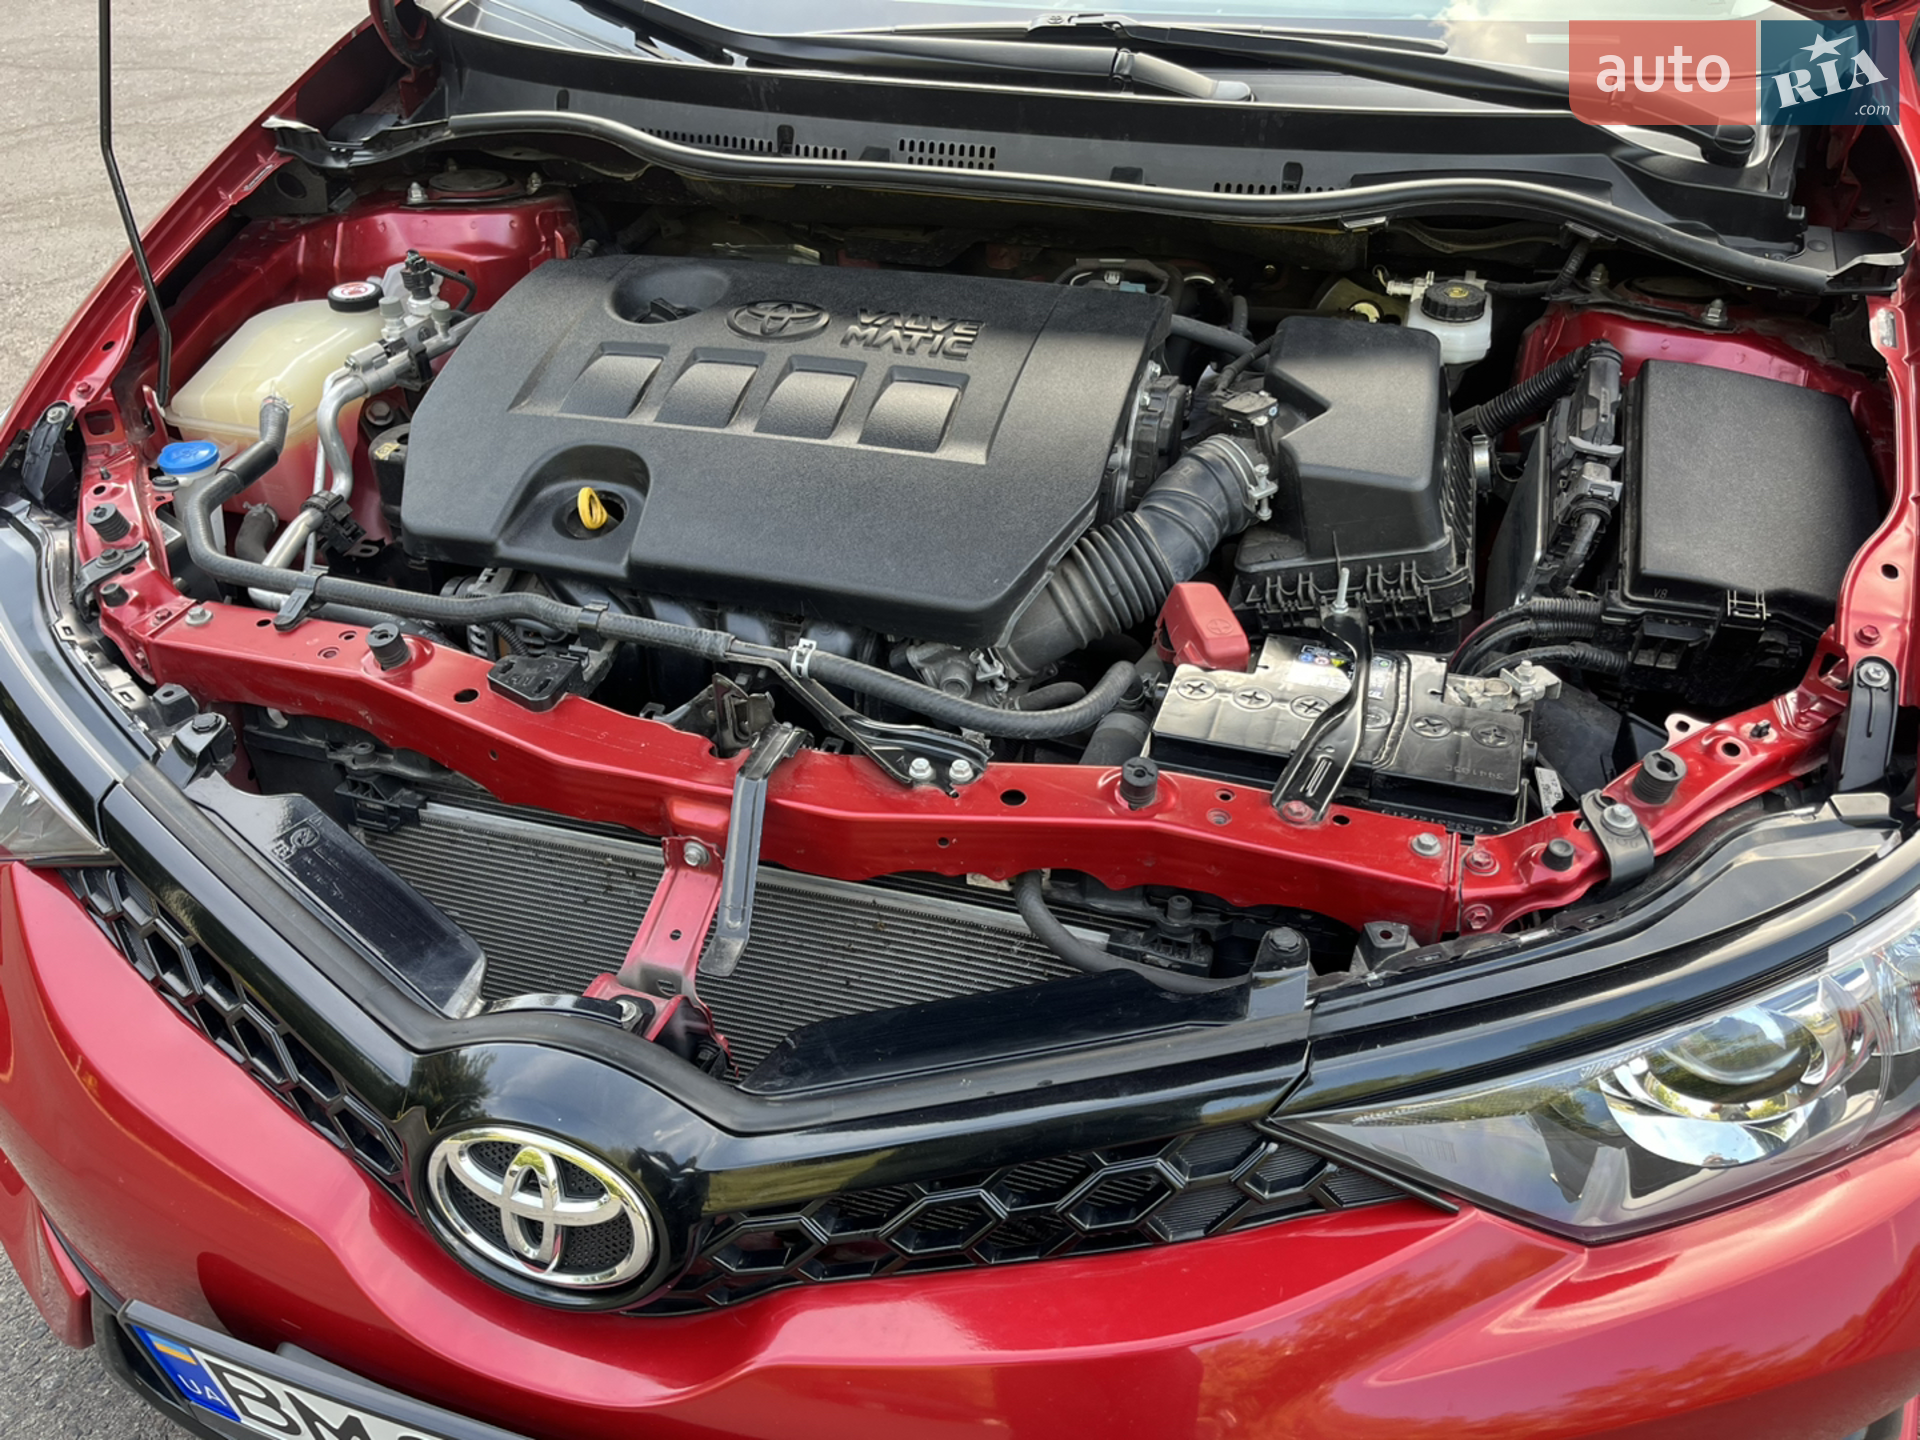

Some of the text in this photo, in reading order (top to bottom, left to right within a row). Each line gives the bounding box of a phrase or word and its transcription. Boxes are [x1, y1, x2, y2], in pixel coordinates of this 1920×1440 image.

[858, 308, 985, 335] VALVE
[840, 324, 977, 360] MATIC
[178, 1374, 227, 1406] UA
